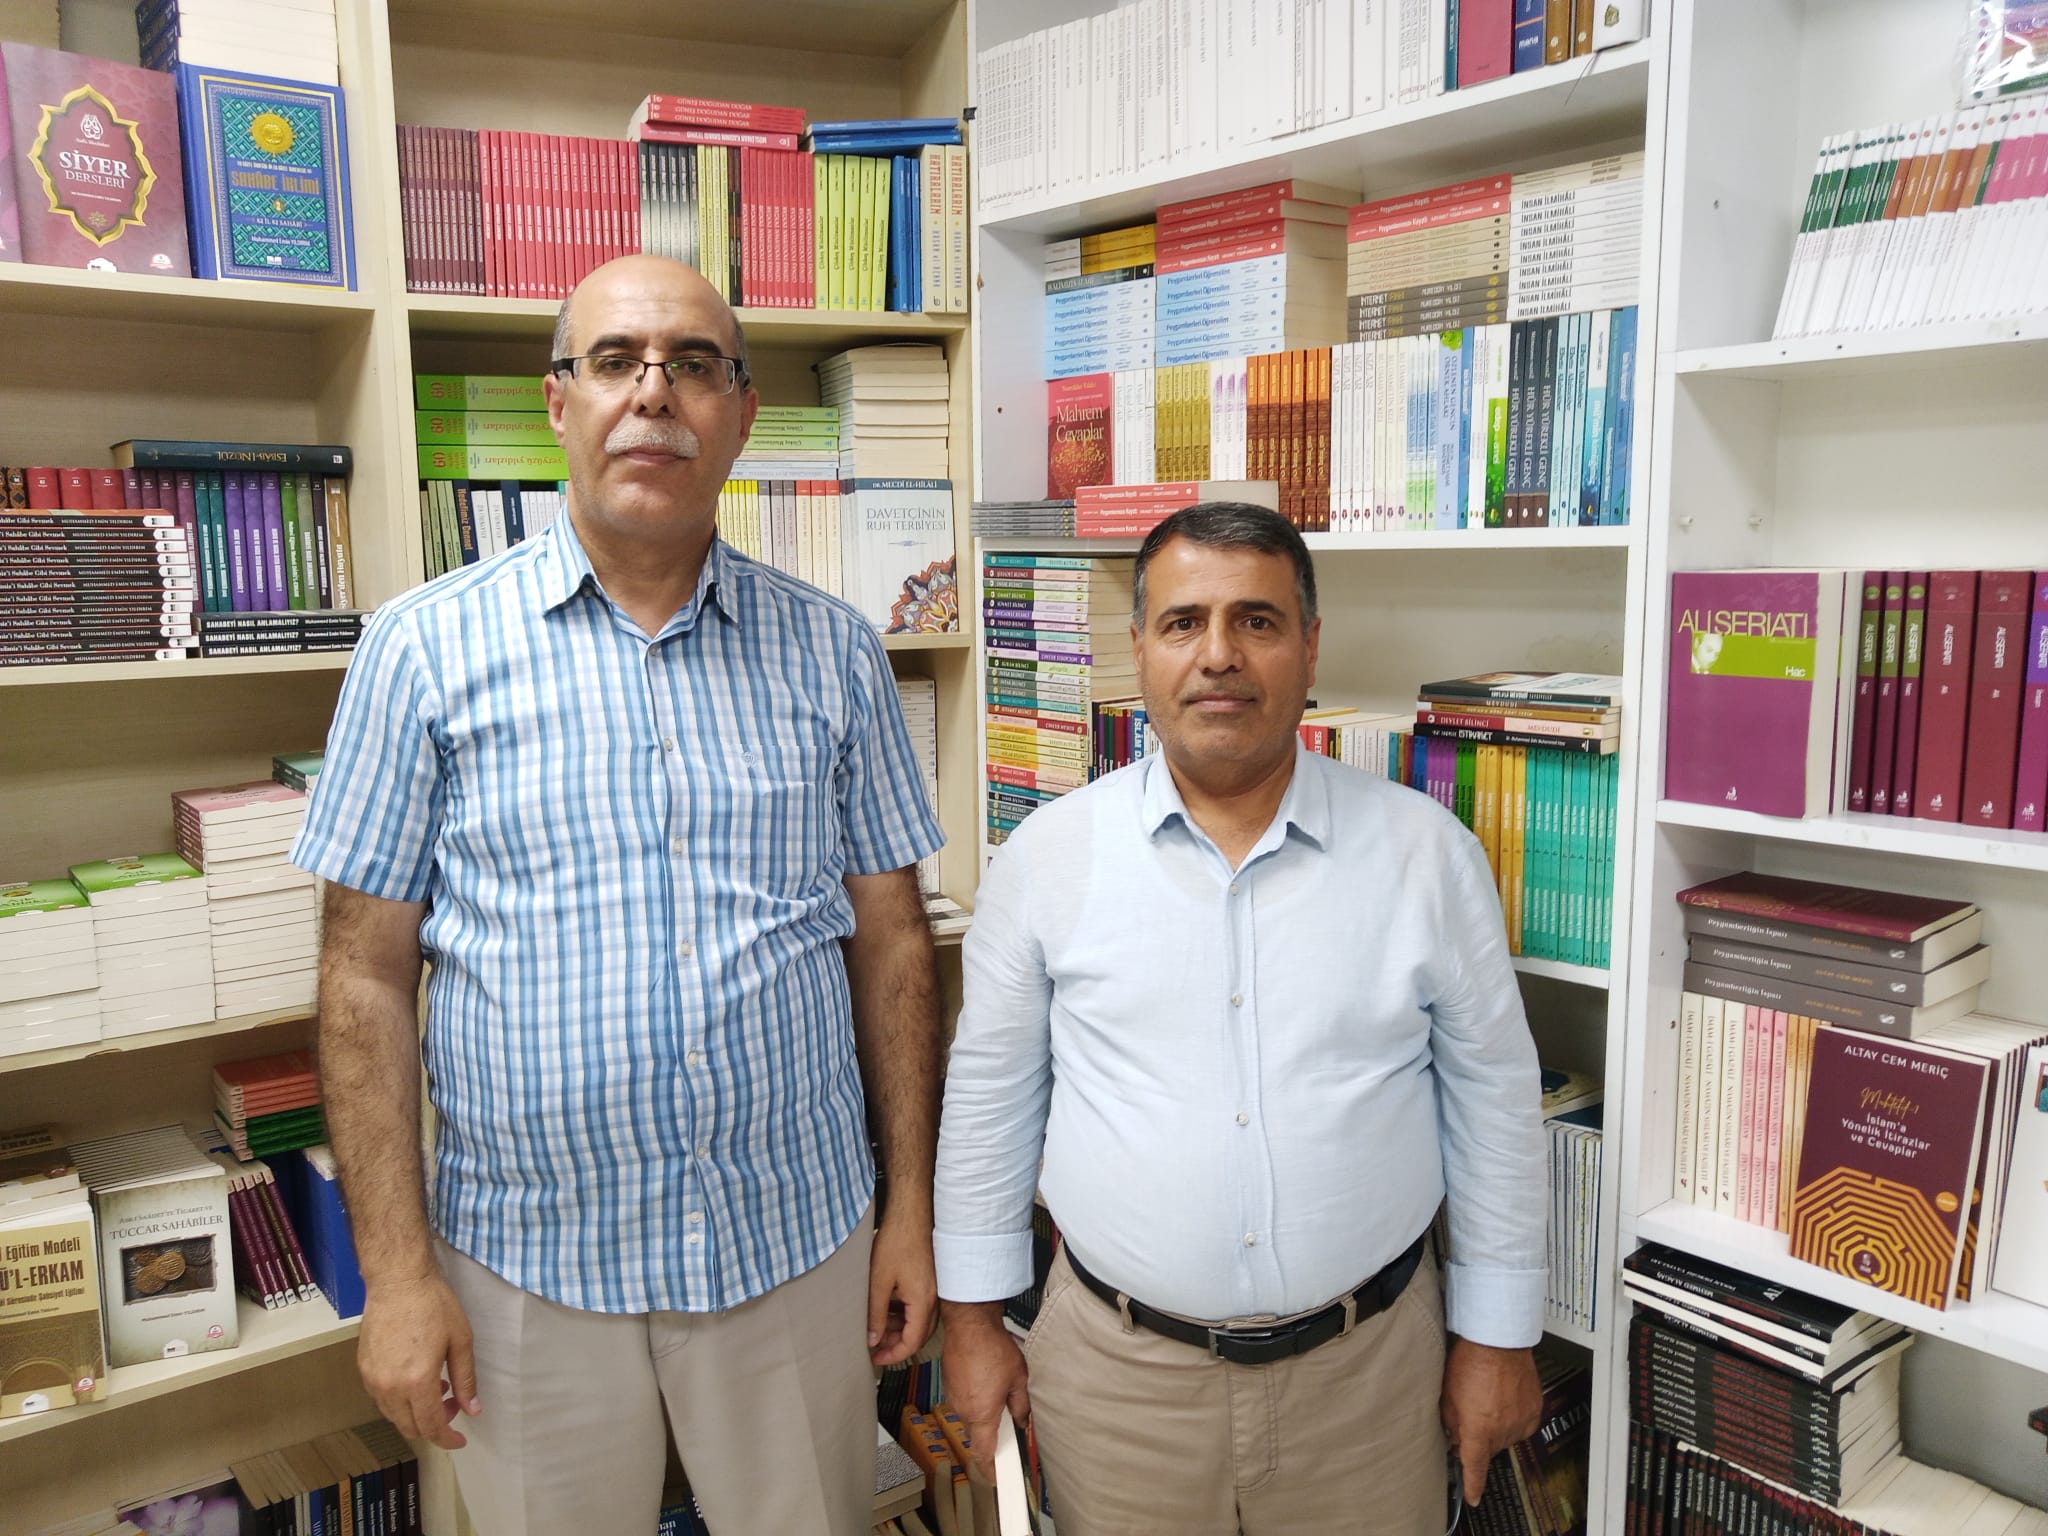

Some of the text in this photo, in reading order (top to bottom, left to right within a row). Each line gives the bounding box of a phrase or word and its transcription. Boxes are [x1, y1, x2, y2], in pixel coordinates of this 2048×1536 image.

[1518, 36, 1539, 49] mana
[60, 150, 131, 179] SİYER
[66, 170, 125, 188] DERSLERİ
[1056, 403, 1104, 423] Mahrem
[1056, 422, 1105, 448] Cevaplar
[1507, 388, 1521, 489] HÜR YÜREKLİ GENÇ
[1521, 386, 1537, 488] HÜR YÜREKLİ GENÇ
[1536, 385, 1553, 488] HÜR YÜREKLİ GENÇ
[485, 456, 562, 465] yeryüzü yıldızları
[866, 506, 945, 520] DAVETÇİNİN
[866, 520, 946, 531] RUH TERBİYESİ
[1785, 665, 1806, 677] Hac
[1844, 1045, 1950, 1080] ALTAY CEM MERİÇ
[1866, 1112, 1907, 1133] İslam'a
[1842, 1118, 1931, 1151] Yönelik İtirazlar
[1850, 1134, 1918, 1159] ve Cevaplar
[110, 1224, 160, 1240] TÜCCAR
[6, 1243, 40, 1262] Eğitim
